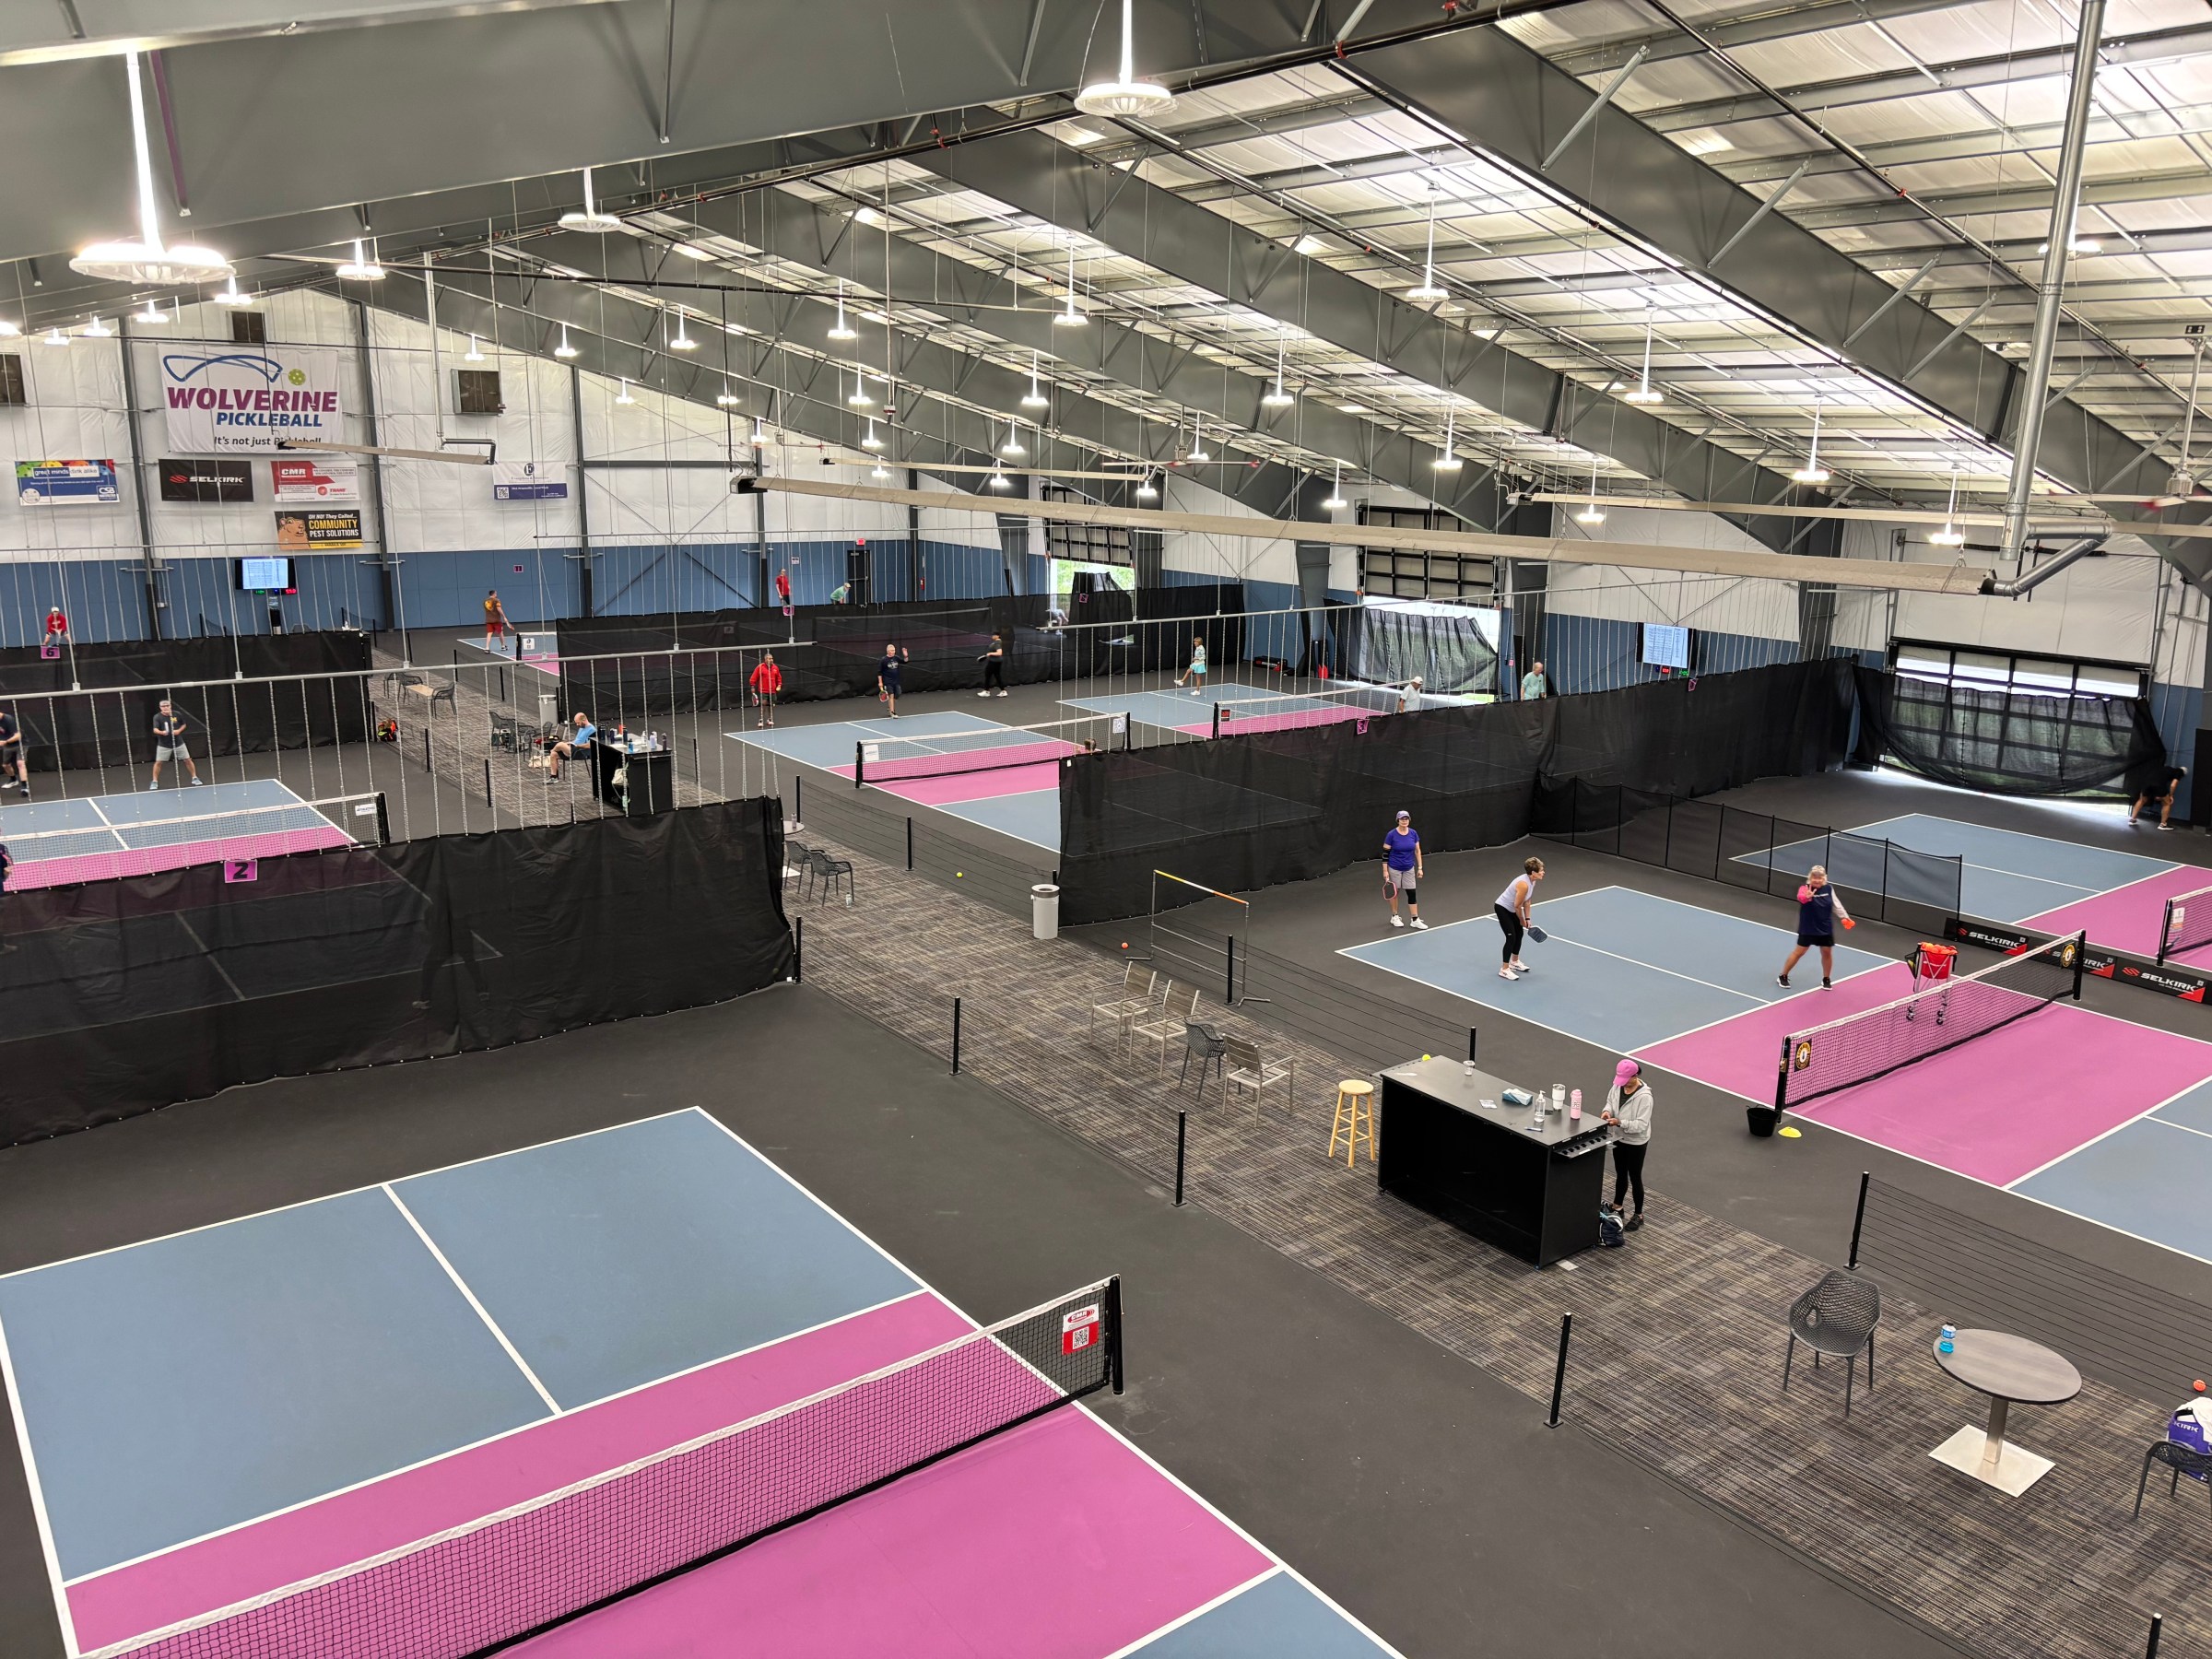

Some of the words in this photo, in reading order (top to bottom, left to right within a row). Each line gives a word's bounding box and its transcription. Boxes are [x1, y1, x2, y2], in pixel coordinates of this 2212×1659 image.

[168, 387, 337, 412] WOLVERINE
[217, 412, 323, 427] PICKLEBALL
[214, 436, 229, 445] It's
[232, 437, 250, 445] not
[250, 436, 271, 447] just
[309, 519, 358, 530] COMMUNITY
[325, 529, 359, 537] SOLUTIONS
[46, 647, 55, 657] 6
[232, 863, 249, 880] 2
[1969, 931, 2021, 948] SELKIRK
[2140, 972, 2198, 993] SELKIRK
